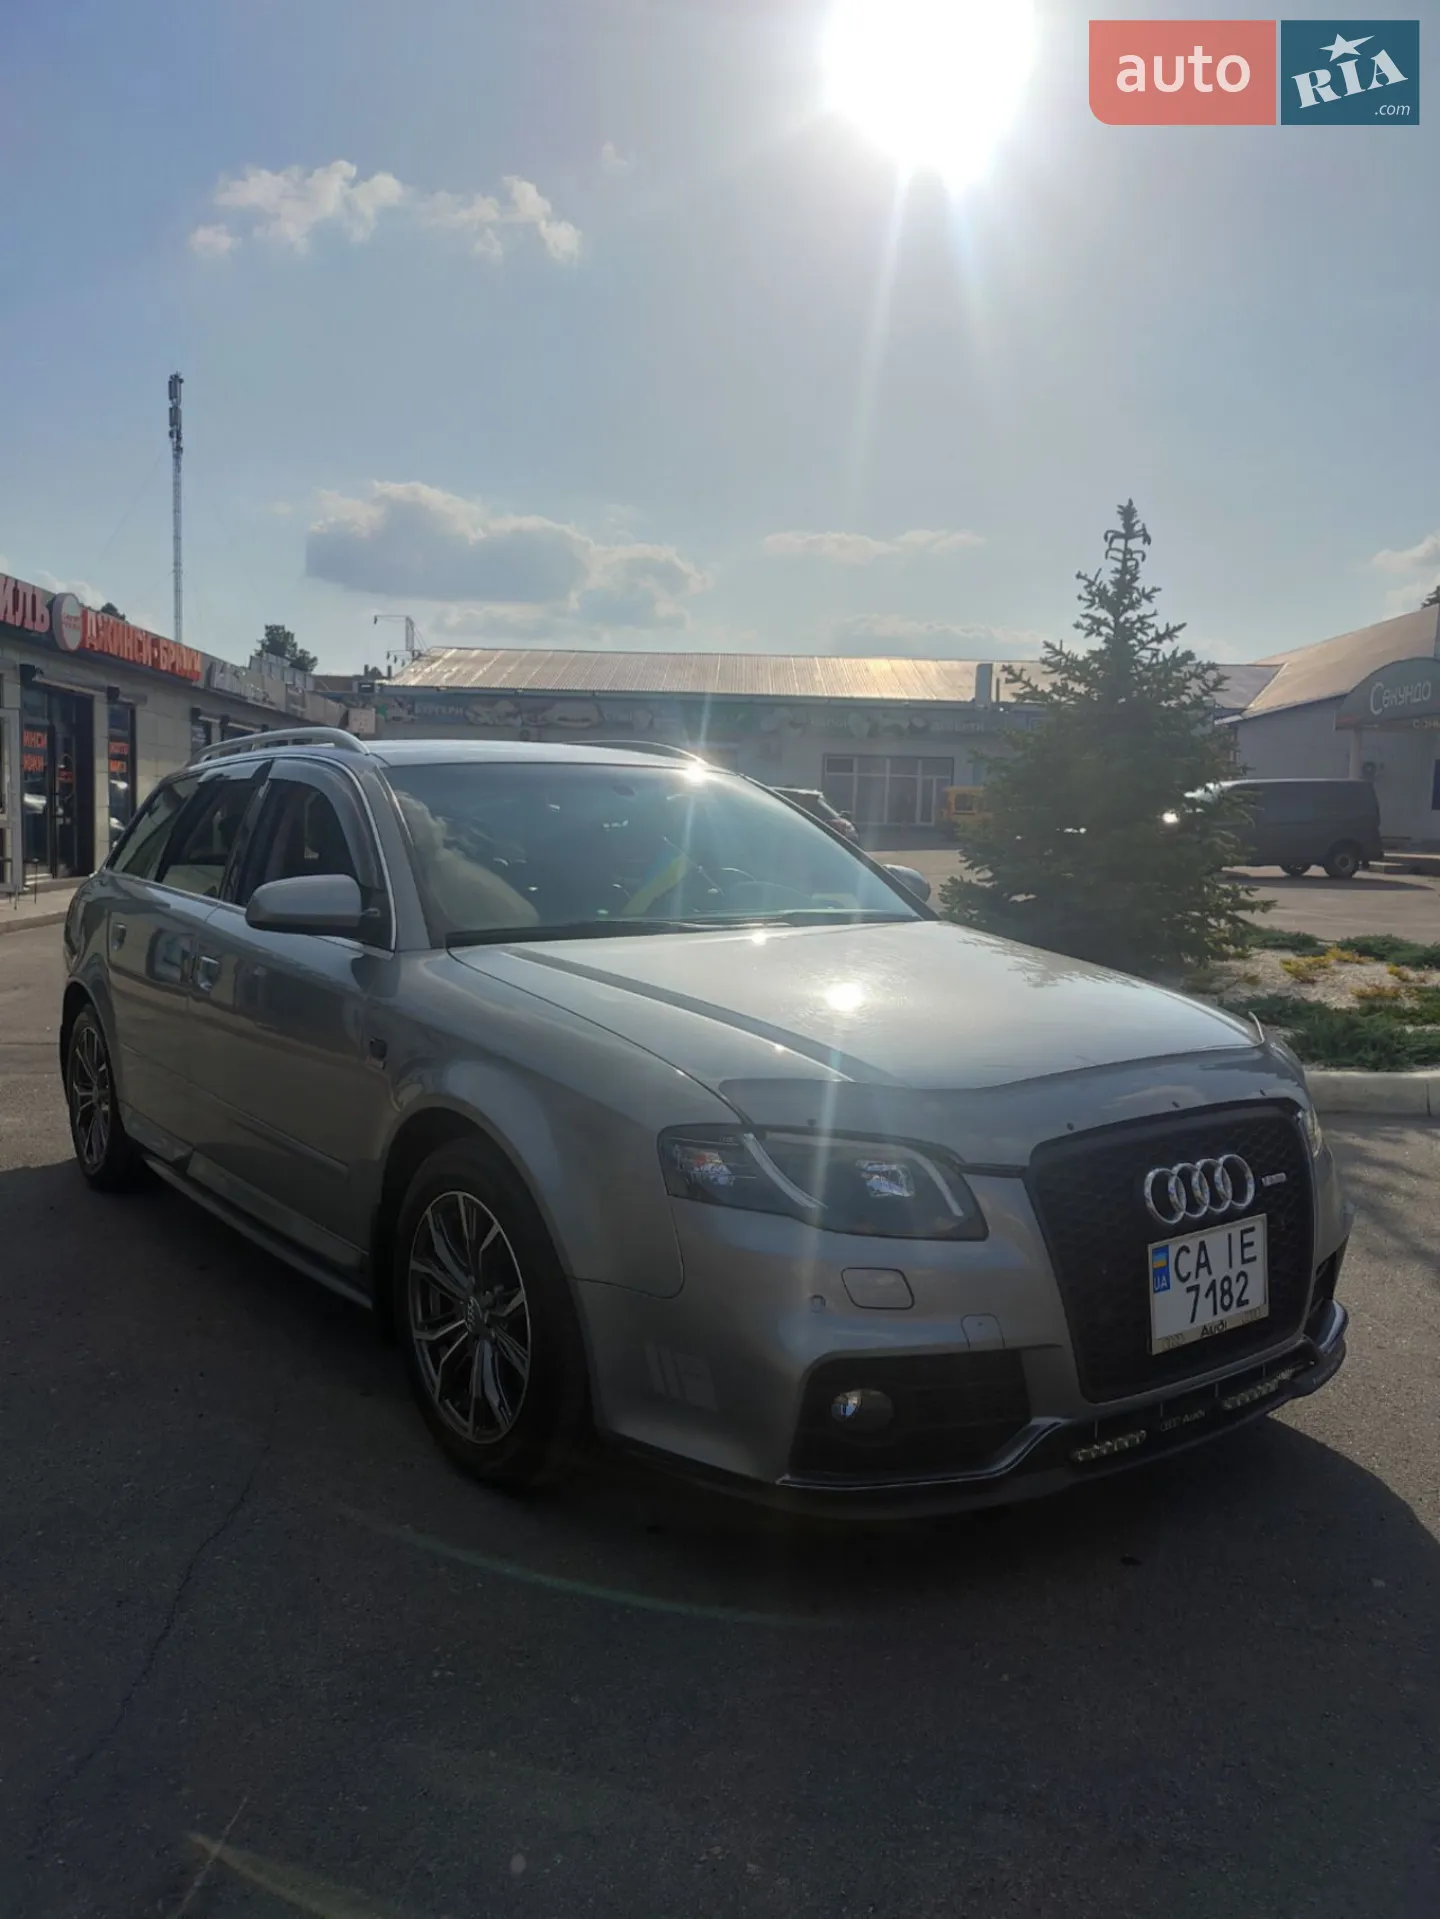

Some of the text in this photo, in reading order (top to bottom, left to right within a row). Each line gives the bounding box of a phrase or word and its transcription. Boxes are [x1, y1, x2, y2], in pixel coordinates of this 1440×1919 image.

[1174, 1226, 1257, 1283] CA IE
[1154, 1275, 1168, 1291] UA
[1186, 1271, 1250, 1323] 7182
[1201, 1319, 1228, 1338] Audi
